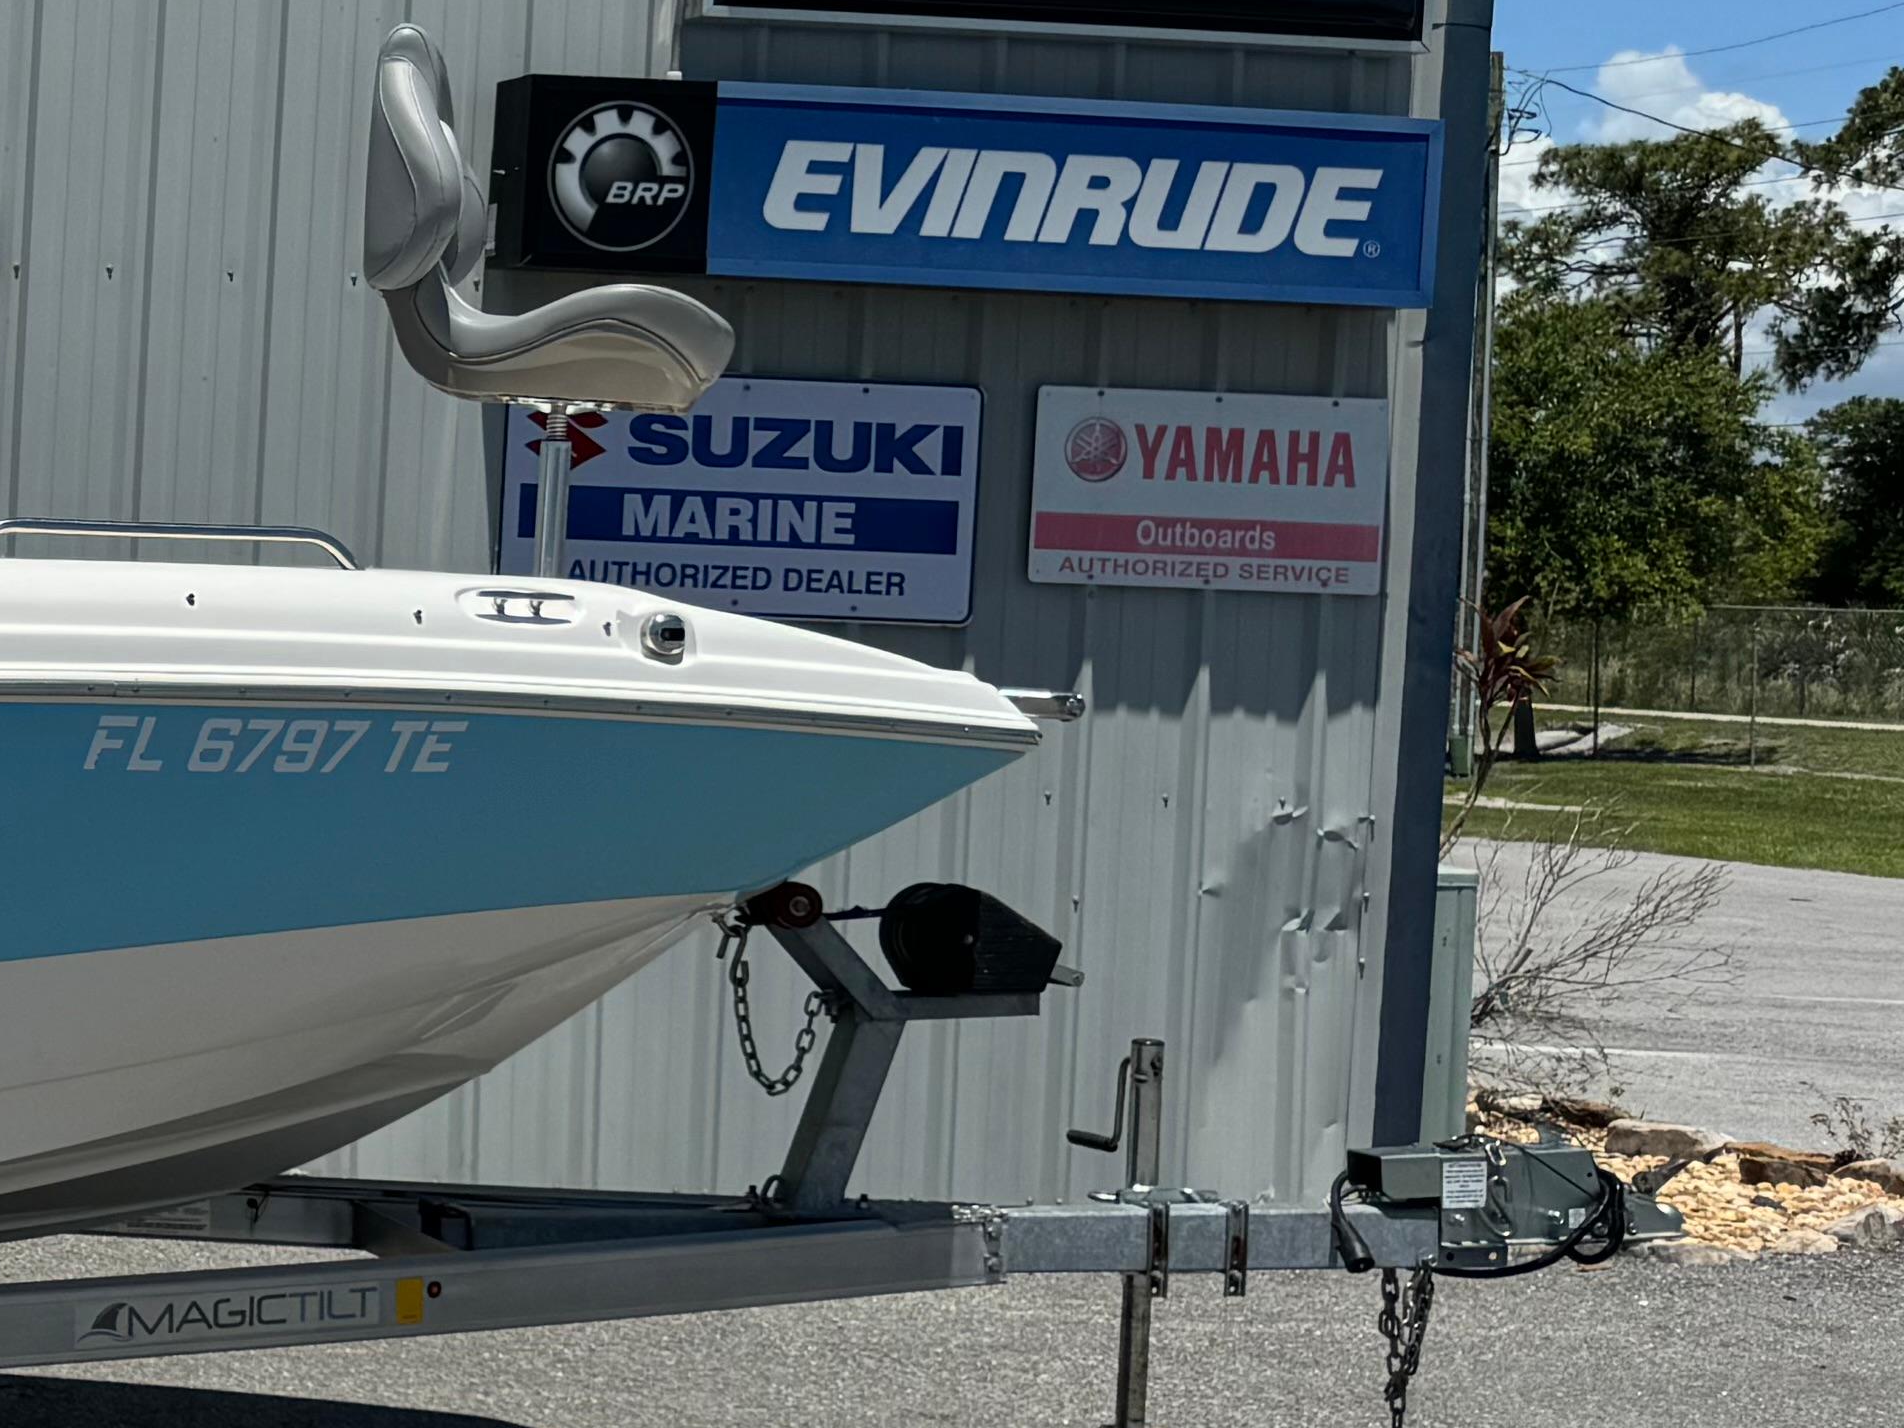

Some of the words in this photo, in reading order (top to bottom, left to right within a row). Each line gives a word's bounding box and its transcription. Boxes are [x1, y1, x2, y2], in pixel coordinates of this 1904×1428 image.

[605, 181, 685, 207] BRP
[762, 139, 1384, 258] EVINRUDE
[627, 412, 964, 477] SUZUKI
[1134, 423, 1357, 489] YAMAHA
[621, 492, 857, 545] MARINE
[1136, 520, 1277, 552] Outboards
[568, 558, 772, 592] AUTHORIZED
[782, 567, 906, 597] DEALER
[1059, 556, 1230, 580] AUTHORIZED
[1238, 563, 1350, 584] SERVICE
[83, 715, 164, 771] FL
[187, 717, 373, 772] 6797
[384, 720, 470, 772] TE
[127, 1286, 379, 1336] MAGICTILT
